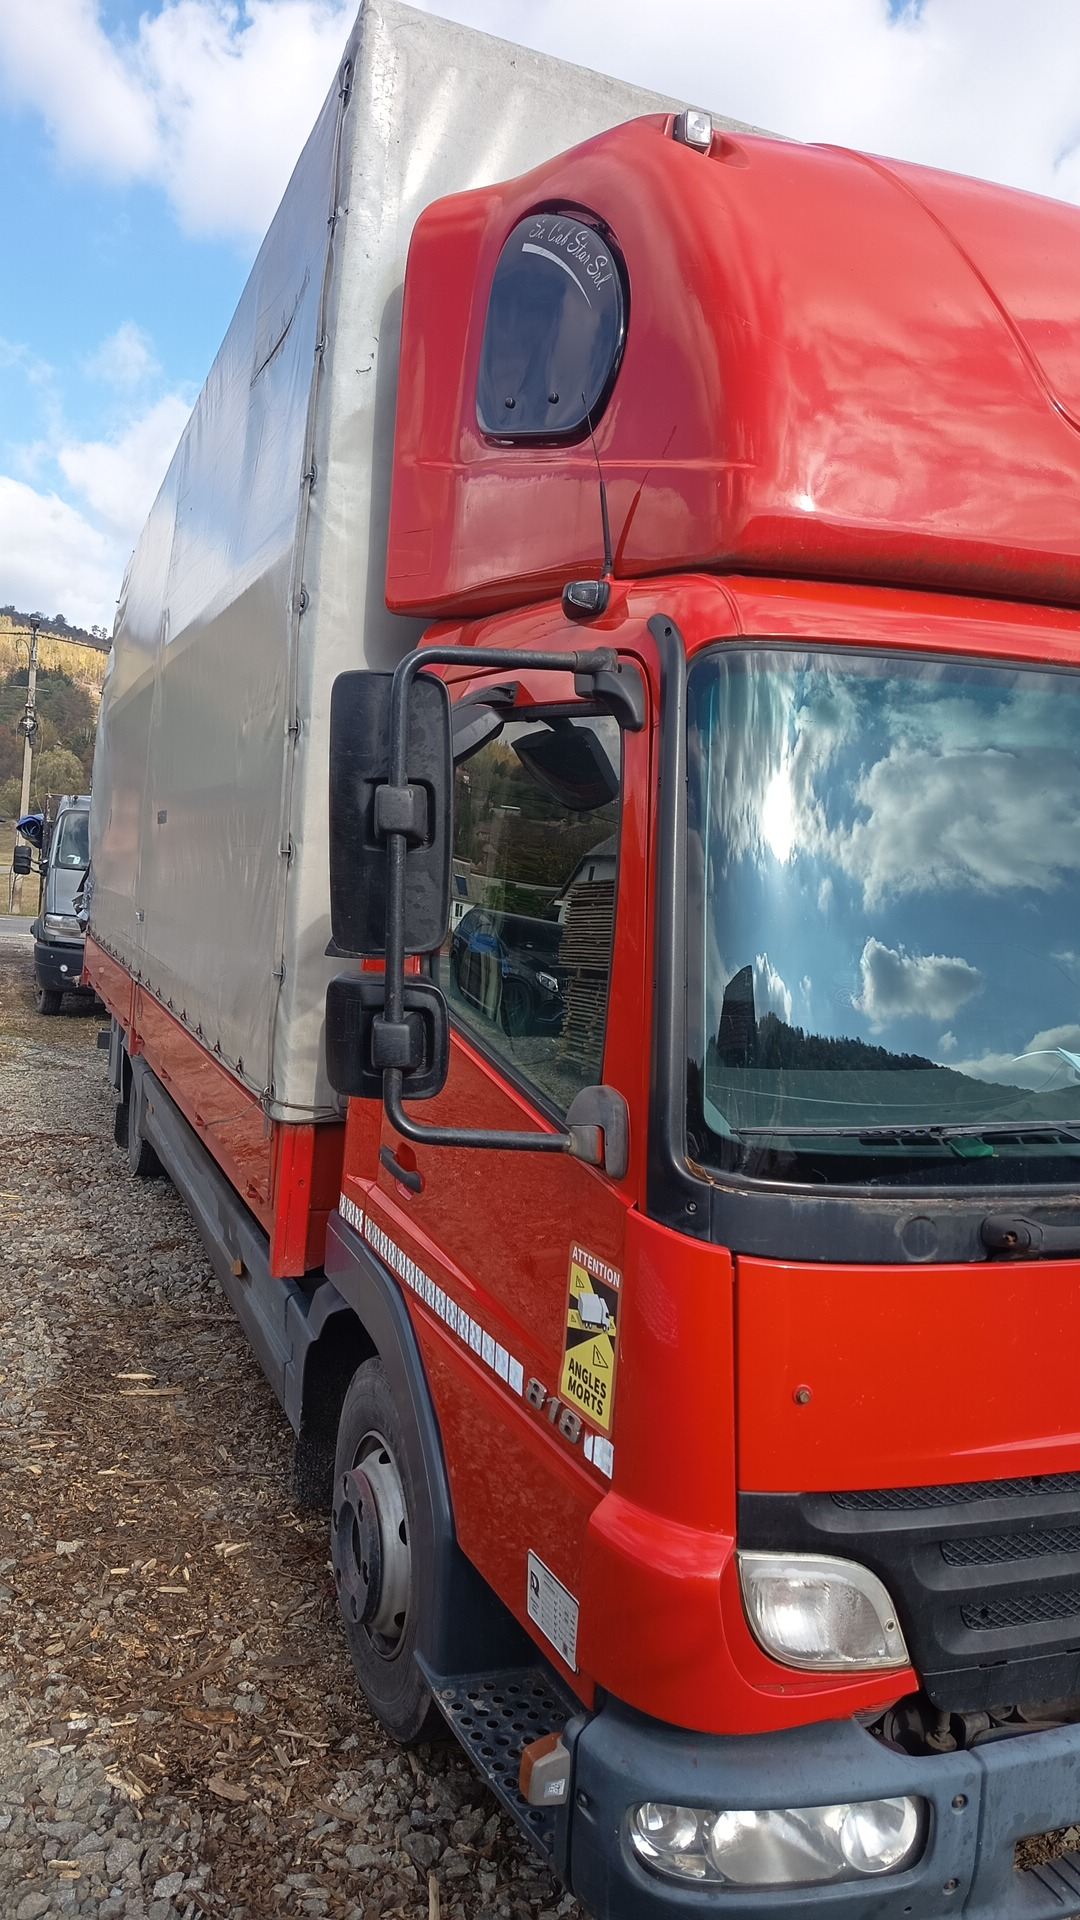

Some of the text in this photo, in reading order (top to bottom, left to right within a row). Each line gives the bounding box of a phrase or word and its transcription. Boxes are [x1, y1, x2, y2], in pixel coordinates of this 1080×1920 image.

[548, 222, 576, 246] Cab
[566, 230, 592, 265] Star
[572, 1245, 620, 1288] ATTENTION
[567, 1375, 604, 1417] MORTS
[568, 1357, 607, 1400] ANGLES
[527, 1377, 583, 1445] 818
